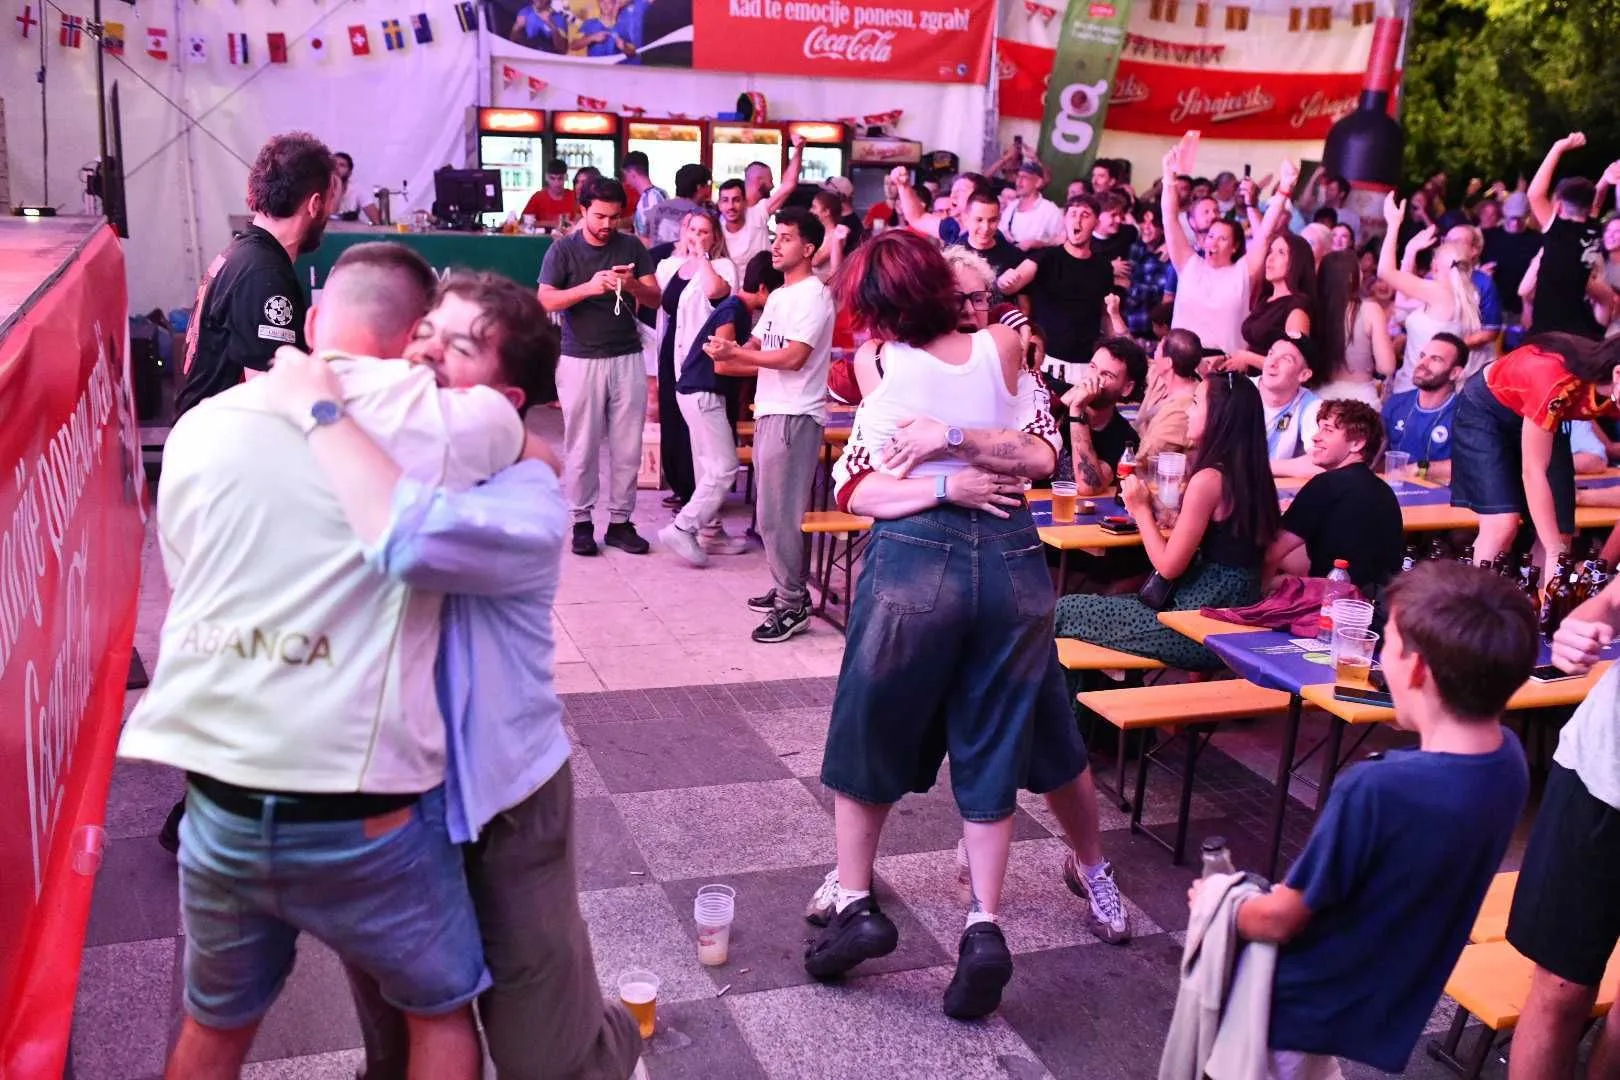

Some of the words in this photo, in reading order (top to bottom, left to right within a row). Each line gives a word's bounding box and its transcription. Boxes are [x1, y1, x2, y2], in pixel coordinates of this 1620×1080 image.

[765, 0, 782, 19] te
[784, 0, 850, 28] emocije
[854, 6, 917, 29] ponesu,
[803, 25, 896, 62] Coca-Cola
[180, 622, 334, 668] ABANCA
